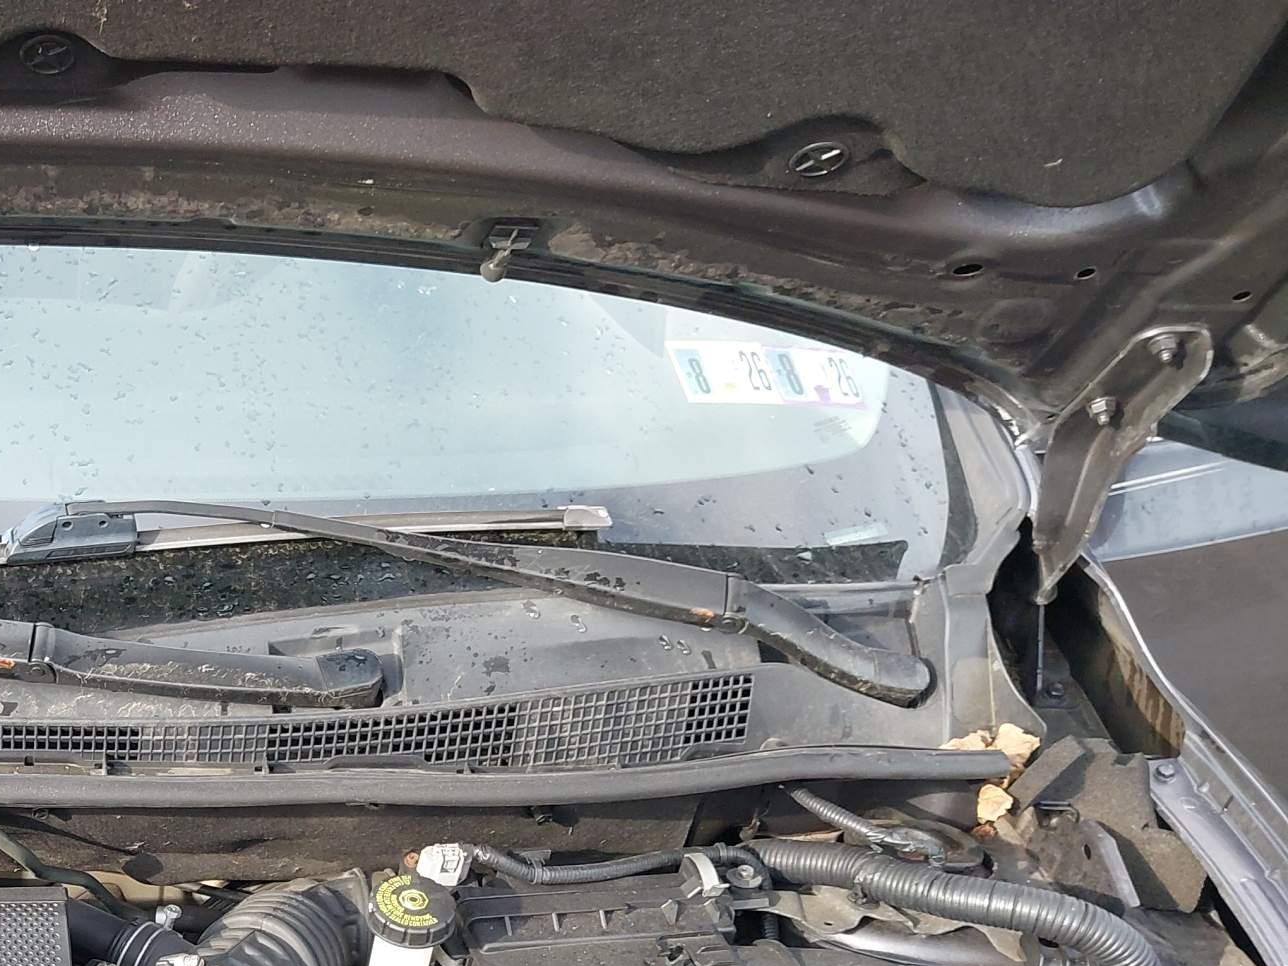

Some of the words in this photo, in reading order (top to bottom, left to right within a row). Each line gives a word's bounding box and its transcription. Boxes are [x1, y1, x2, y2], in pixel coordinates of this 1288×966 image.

[738, 350, 772, 391] 26
[777, 353, 804, 396] 8
[827, 356, 860, 398] 26
